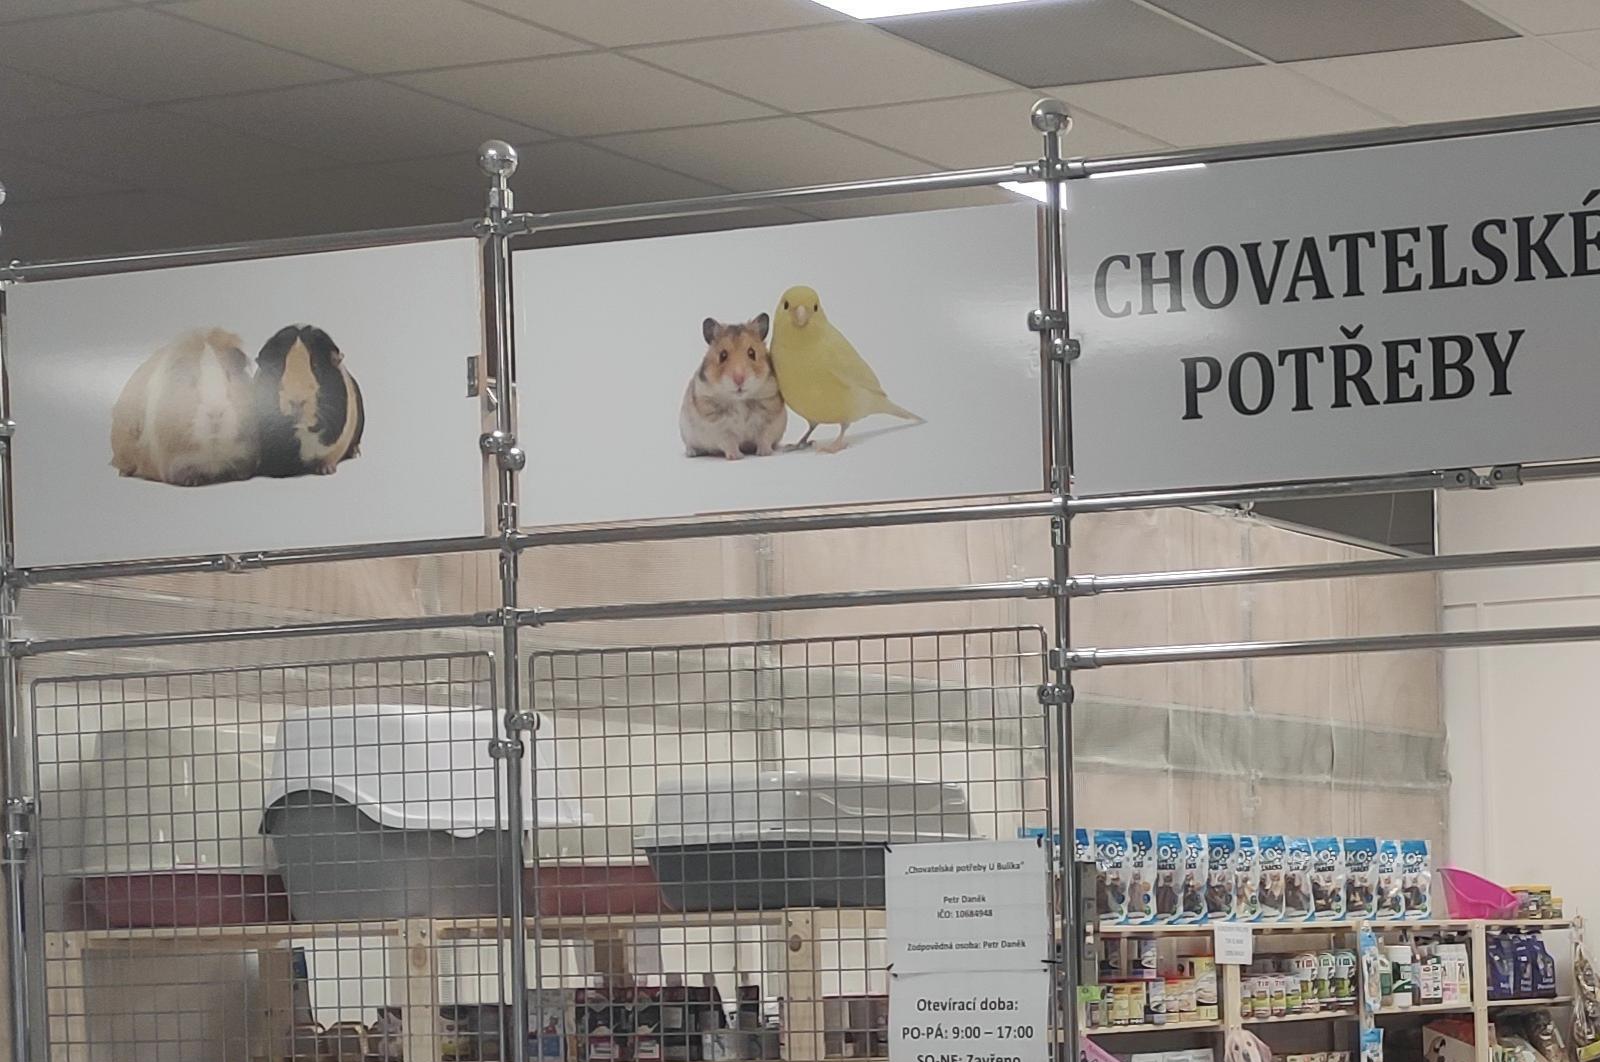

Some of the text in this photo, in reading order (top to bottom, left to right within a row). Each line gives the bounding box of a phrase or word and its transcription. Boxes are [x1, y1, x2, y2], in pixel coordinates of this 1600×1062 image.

[1181, 323, 1526, 420] POTŘEBY
[956, 863, 987, 873] potřeby
[988, 863, 995, 871] U
[943, 894, 986, 904] Petr Daněk
[937, 908, 953, 918] IČO:
[907, 939, 1026, 952] Zodpovědná osoba: Petr Daněk
[916, 997, 1018, 1012] Otevírací doba:
[902, 1024, 948, 1040] PO-PÁ:
[952, 1026, 981, 1039] 9:00
[997, 1025, 1034, 1039] 17:00
